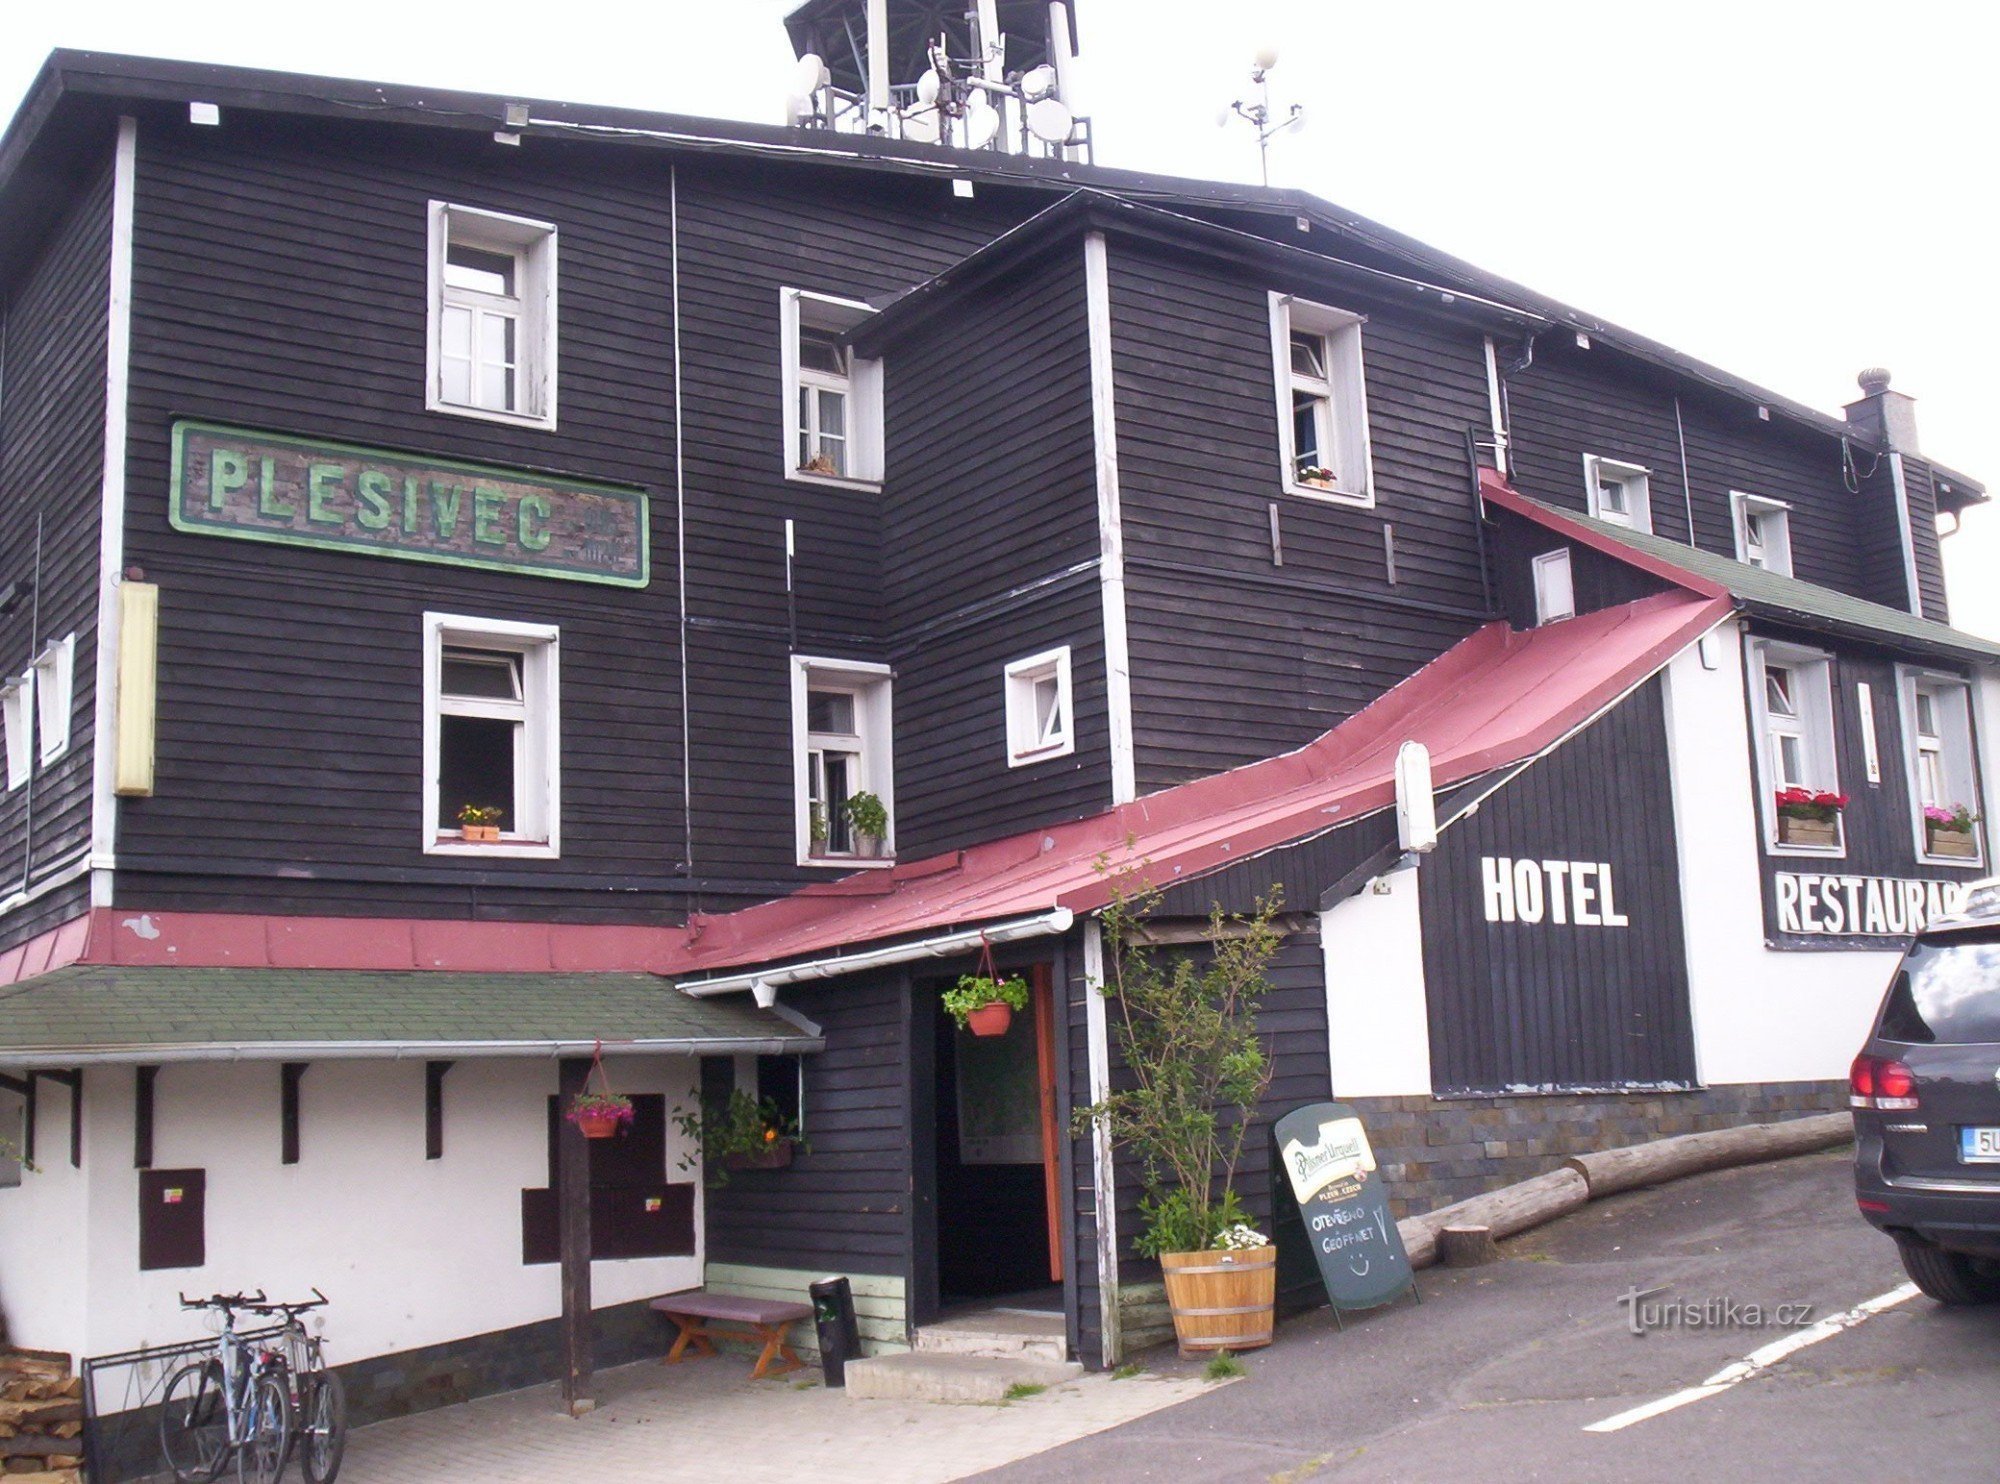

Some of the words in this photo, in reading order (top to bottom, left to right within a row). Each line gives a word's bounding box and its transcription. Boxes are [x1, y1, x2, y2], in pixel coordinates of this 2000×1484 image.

[208, 448, 551, 551] PLESIVEC
[1481, 857, 1629, 927] HOTEL
[1324, 1137, 1360, 1160] Urquell
